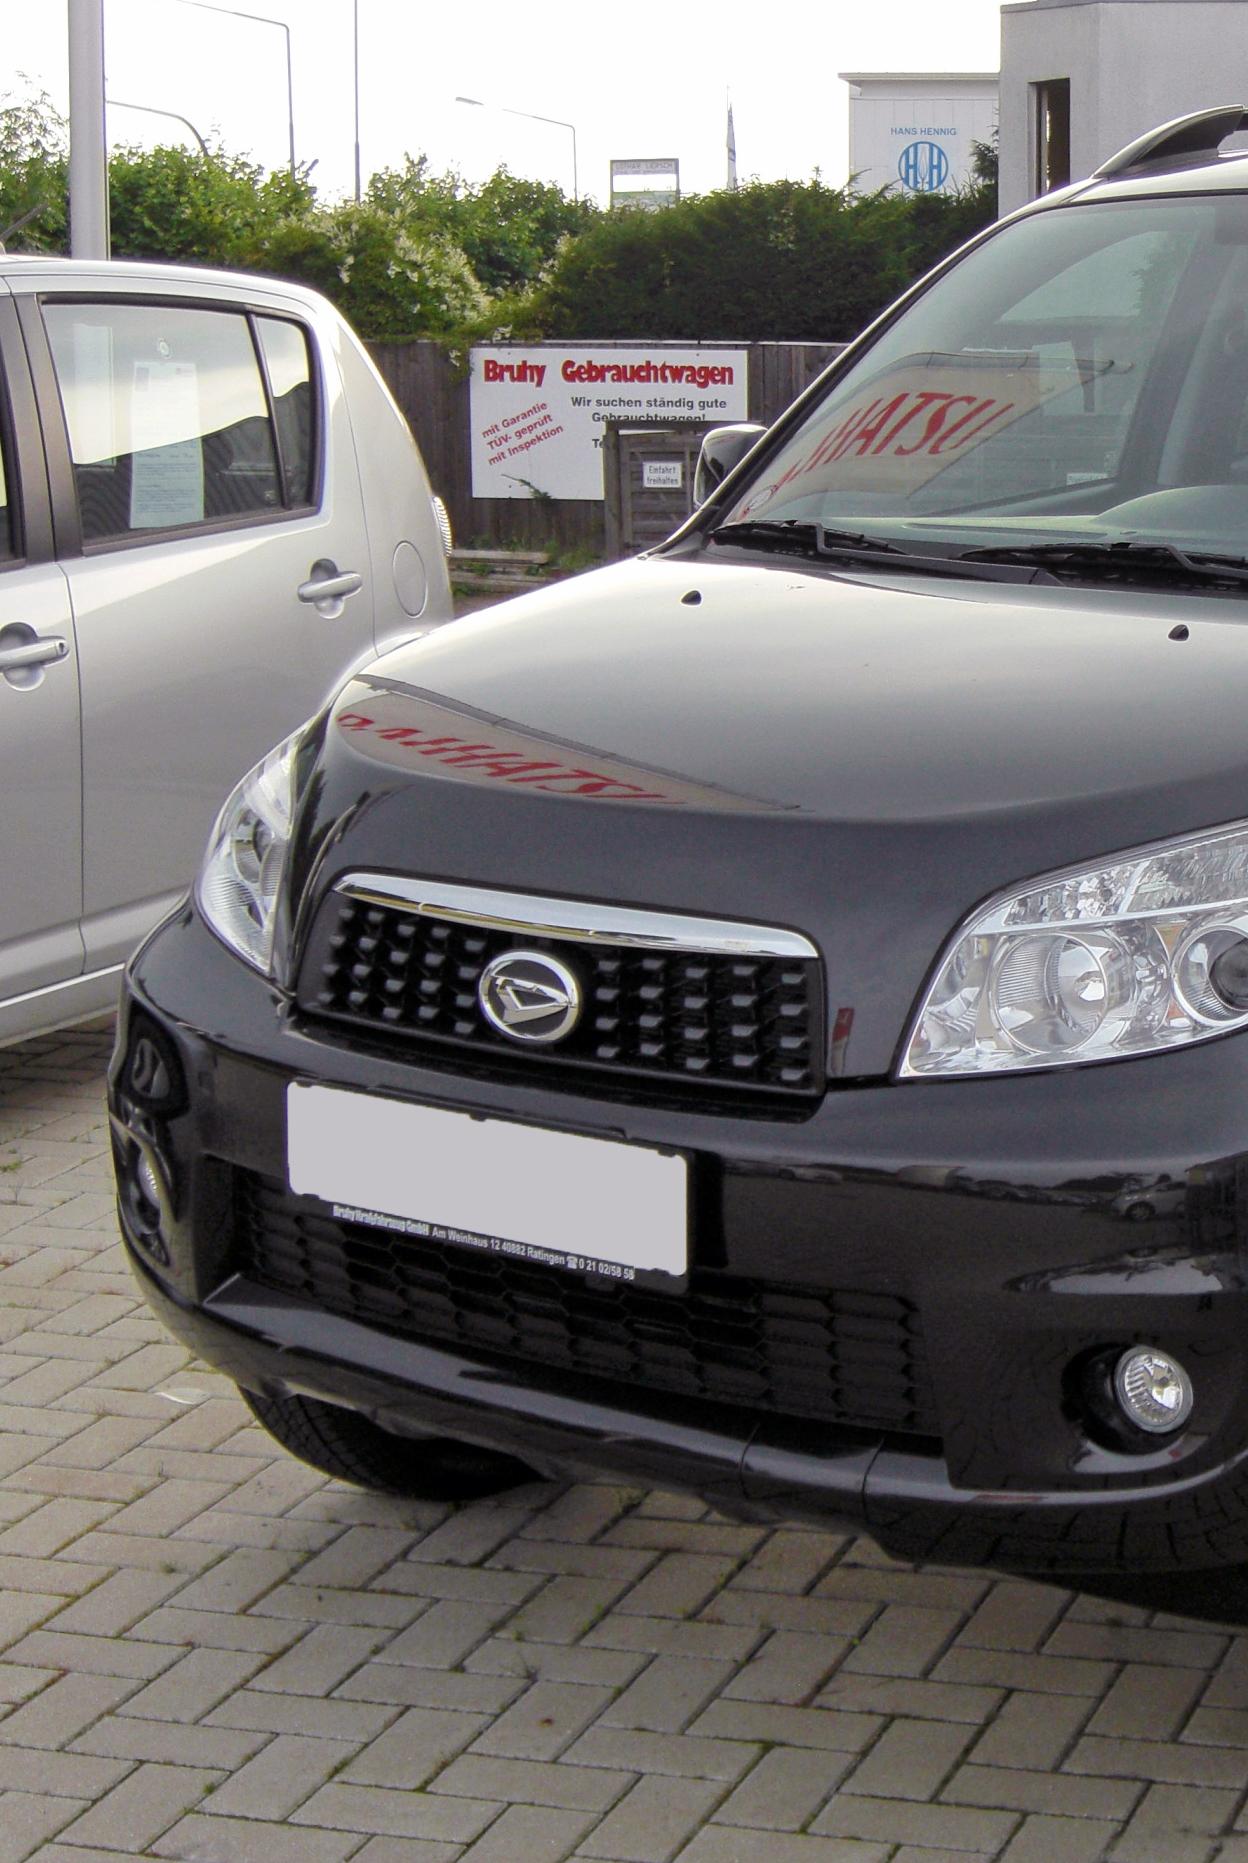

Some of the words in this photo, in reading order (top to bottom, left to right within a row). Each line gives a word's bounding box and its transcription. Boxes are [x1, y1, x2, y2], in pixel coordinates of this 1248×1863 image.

[890, 127, 917, 136] HANS
[919, 127, 957, 136] HENNIG
[484, 359, 546, 387] Bruhy
[561, 360, 734, 389] Gebrauchtwagen
[571, 396, 591, 407] Wir
[595, 397, 642, 408] suchen
[646, 397, 694, 409] ständig
[698, 399, 727, 410] gute
[482, 425, 501, 438] mit
[502, 402, 548, 428] Garantie
[488, 452, 507, 466] mit
[507, 425, 564, 457] Inspektion
[432, 1226, 446, 1239] Am
[447, 1229, 488, 1249] Weinhaus
[490, 1238, 500, 1250] 12
[526, 1246, 566, 1266] Ratingen
